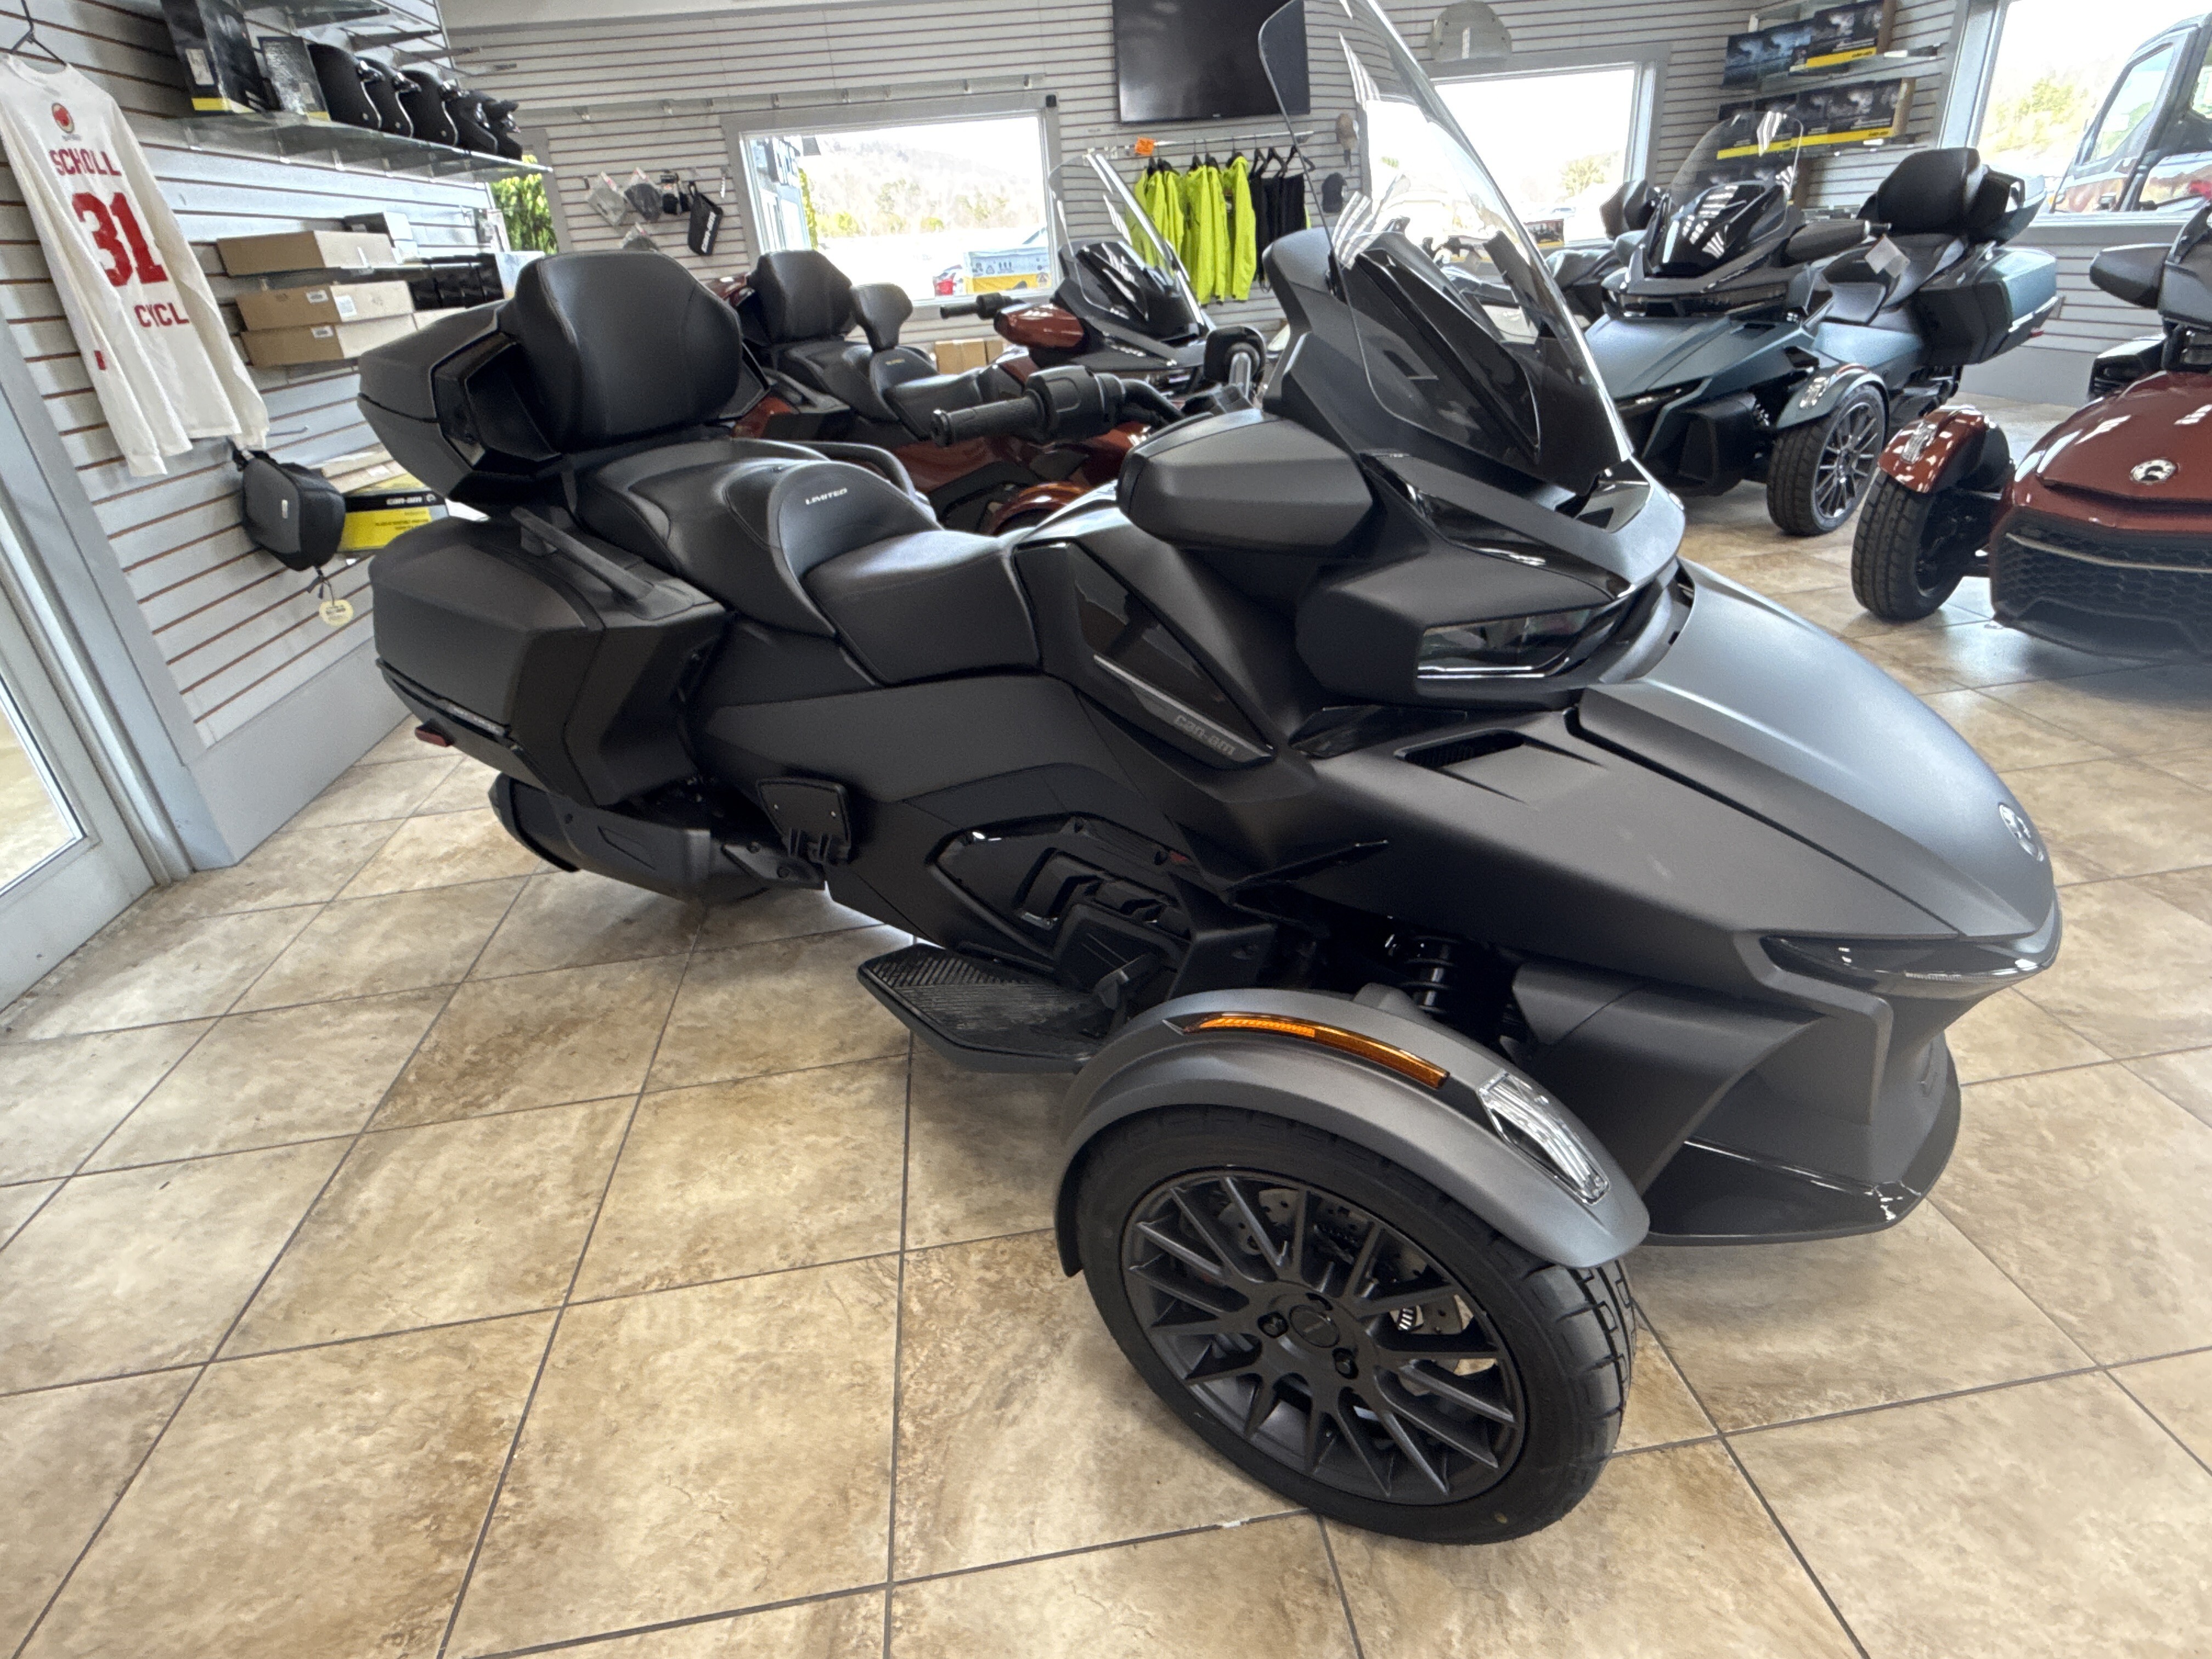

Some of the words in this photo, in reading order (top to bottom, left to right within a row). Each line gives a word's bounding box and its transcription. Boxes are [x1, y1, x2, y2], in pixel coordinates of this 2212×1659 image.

[48, 148, 122, 176] SCHOLL
[72, 192, 168, 287] 31
[805, 488, 848, 505] LIMITED
[1175, 715, 1236, 755] can-am
